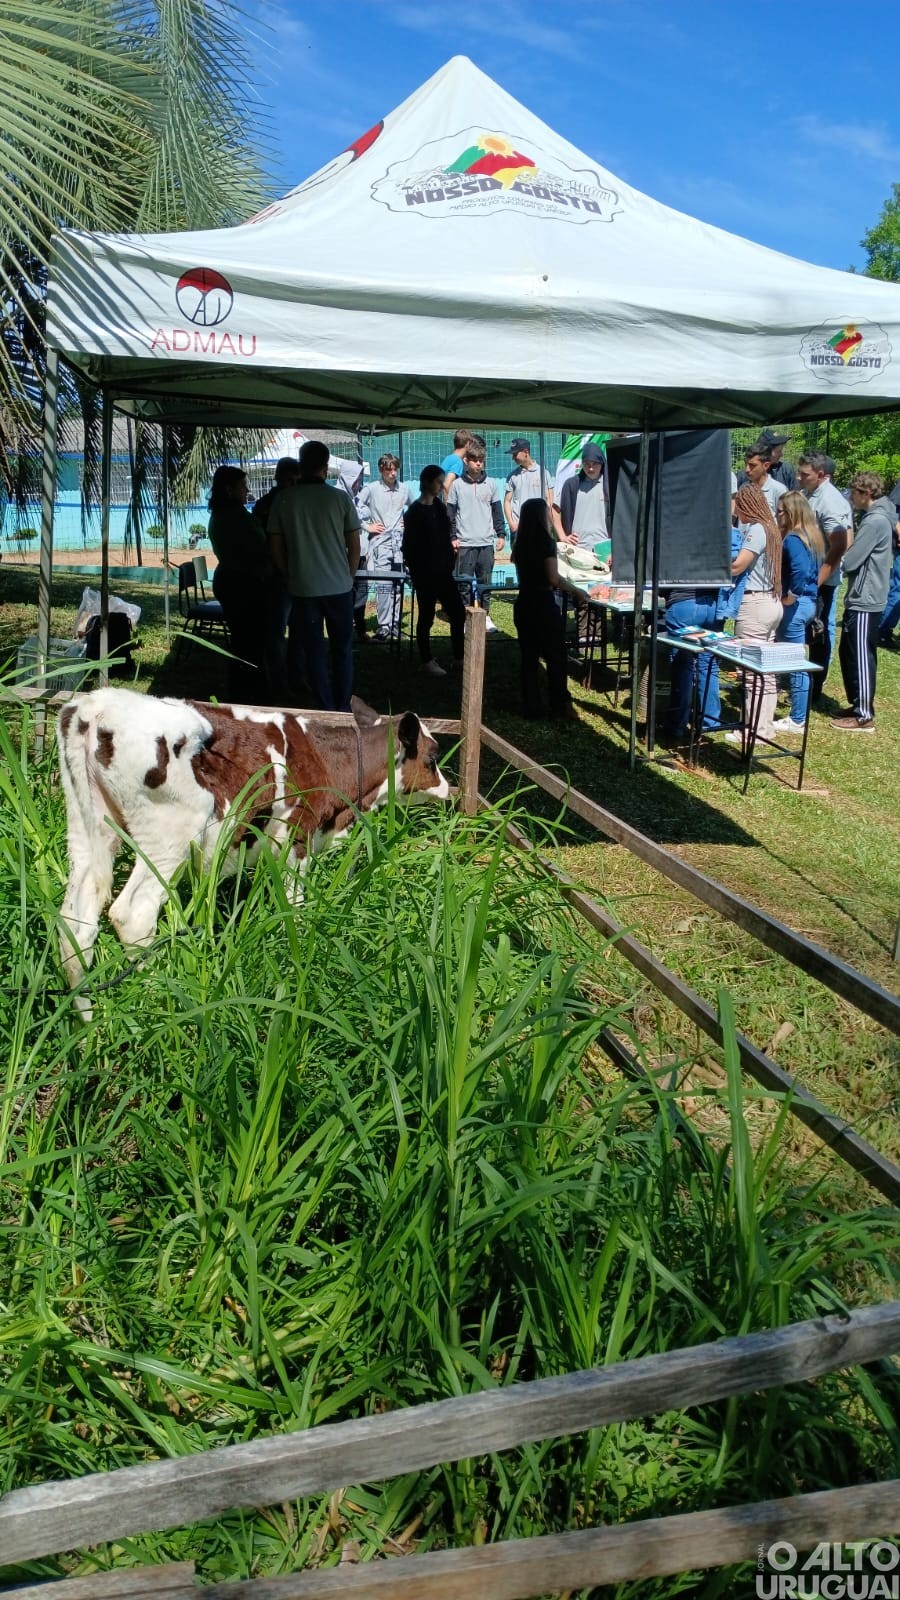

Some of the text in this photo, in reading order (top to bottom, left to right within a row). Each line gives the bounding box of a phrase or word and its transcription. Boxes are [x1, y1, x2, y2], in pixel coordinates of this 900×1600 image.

[405, 177, 602, 215] NOSSO GOSTO
[151, 328, 257, 357] ADMAU
[810, 355, 882, 369] NOSSO GOSTO
